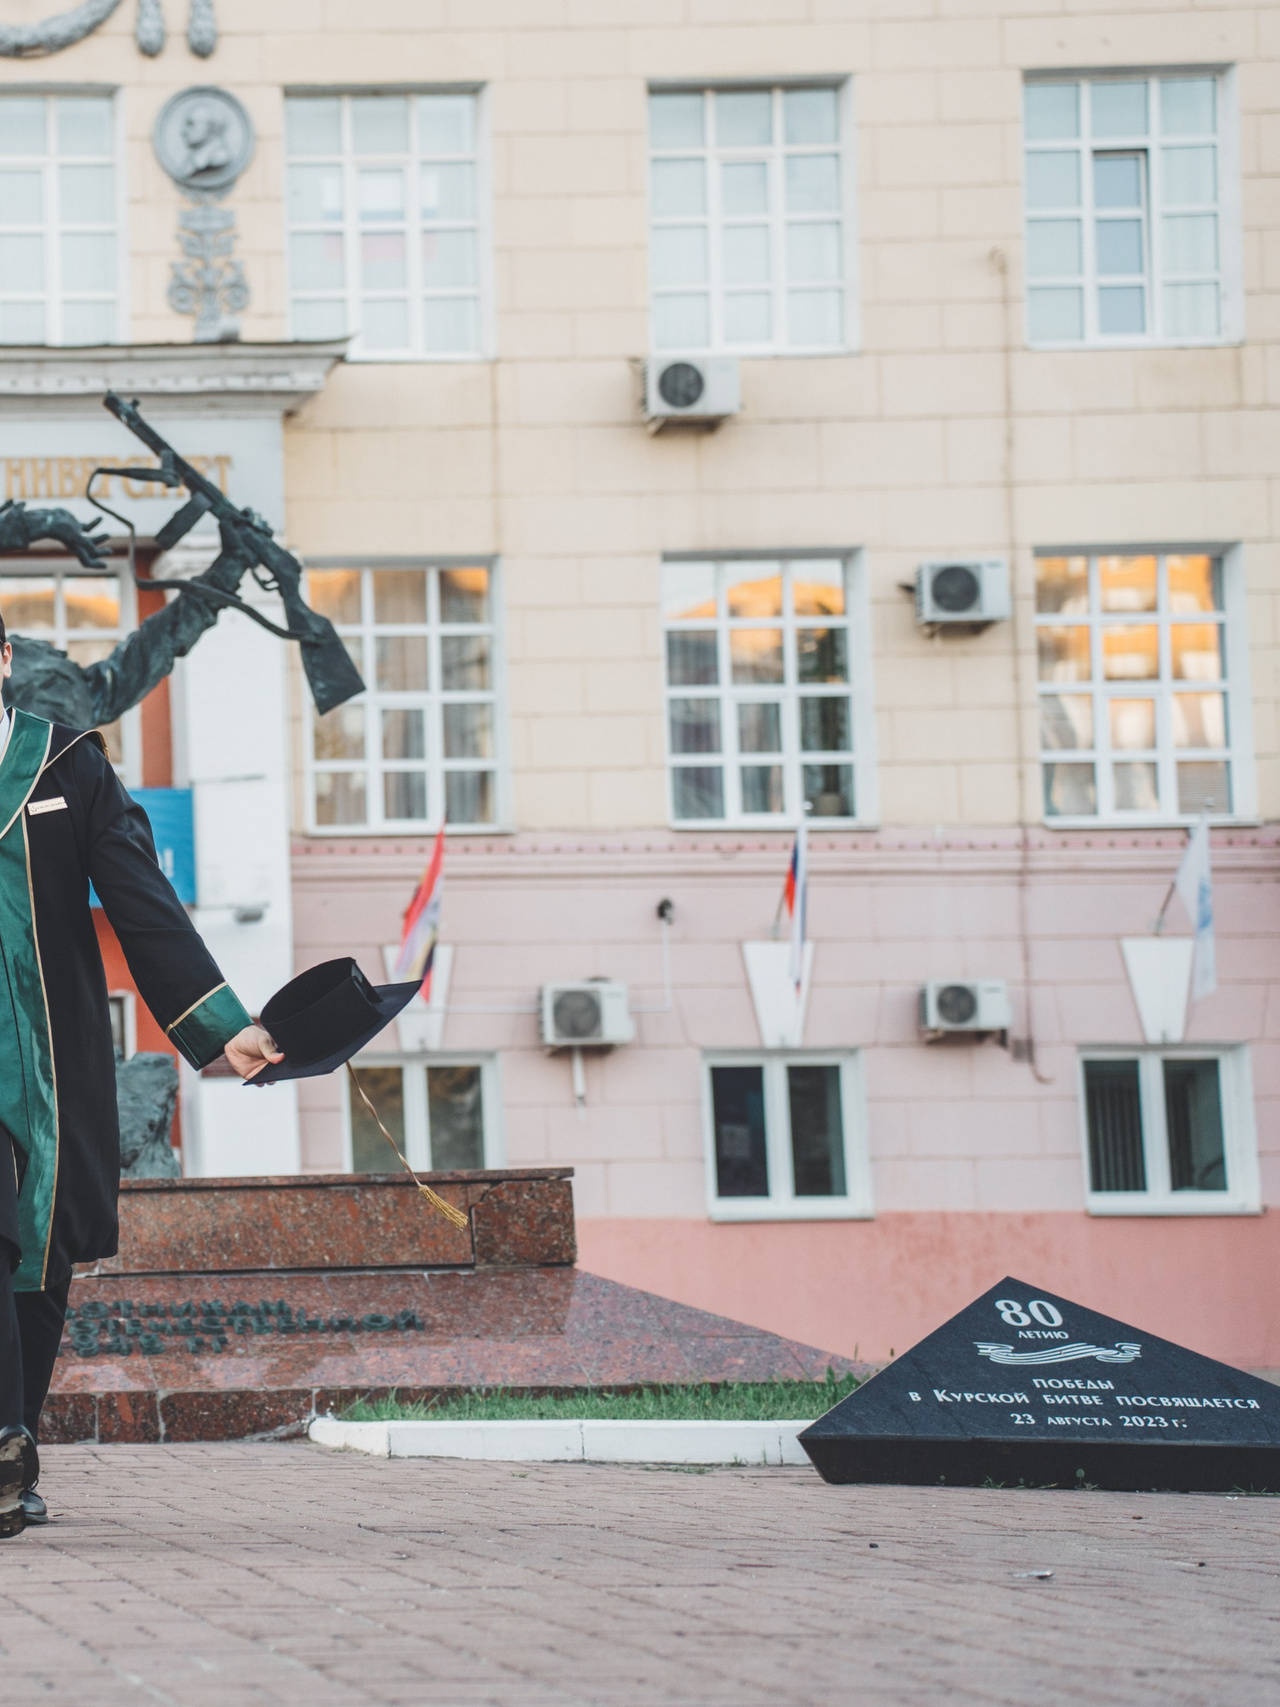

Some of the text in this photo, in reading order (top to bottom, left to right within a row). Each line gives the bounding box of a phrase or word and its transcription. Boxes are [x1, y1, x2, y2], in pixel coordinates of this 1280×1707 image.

[64, 1299, 291, 1320] ОТНИКАМ
[994, 1299, 1063, 1328] 80
[1018, 1330, 1070, 1340] ЛЕТИЮ
[1032, 1378, 1115, 1390] ПОБЕДЫ
[1042, 1394, 1104, 1406] БИТВЕ
[1009, 1413, 1036, 1425] 23
[1047, 1416, 1113, 1427] АВГУСТА
[1118, 1415, 1169, 1428] 2023
